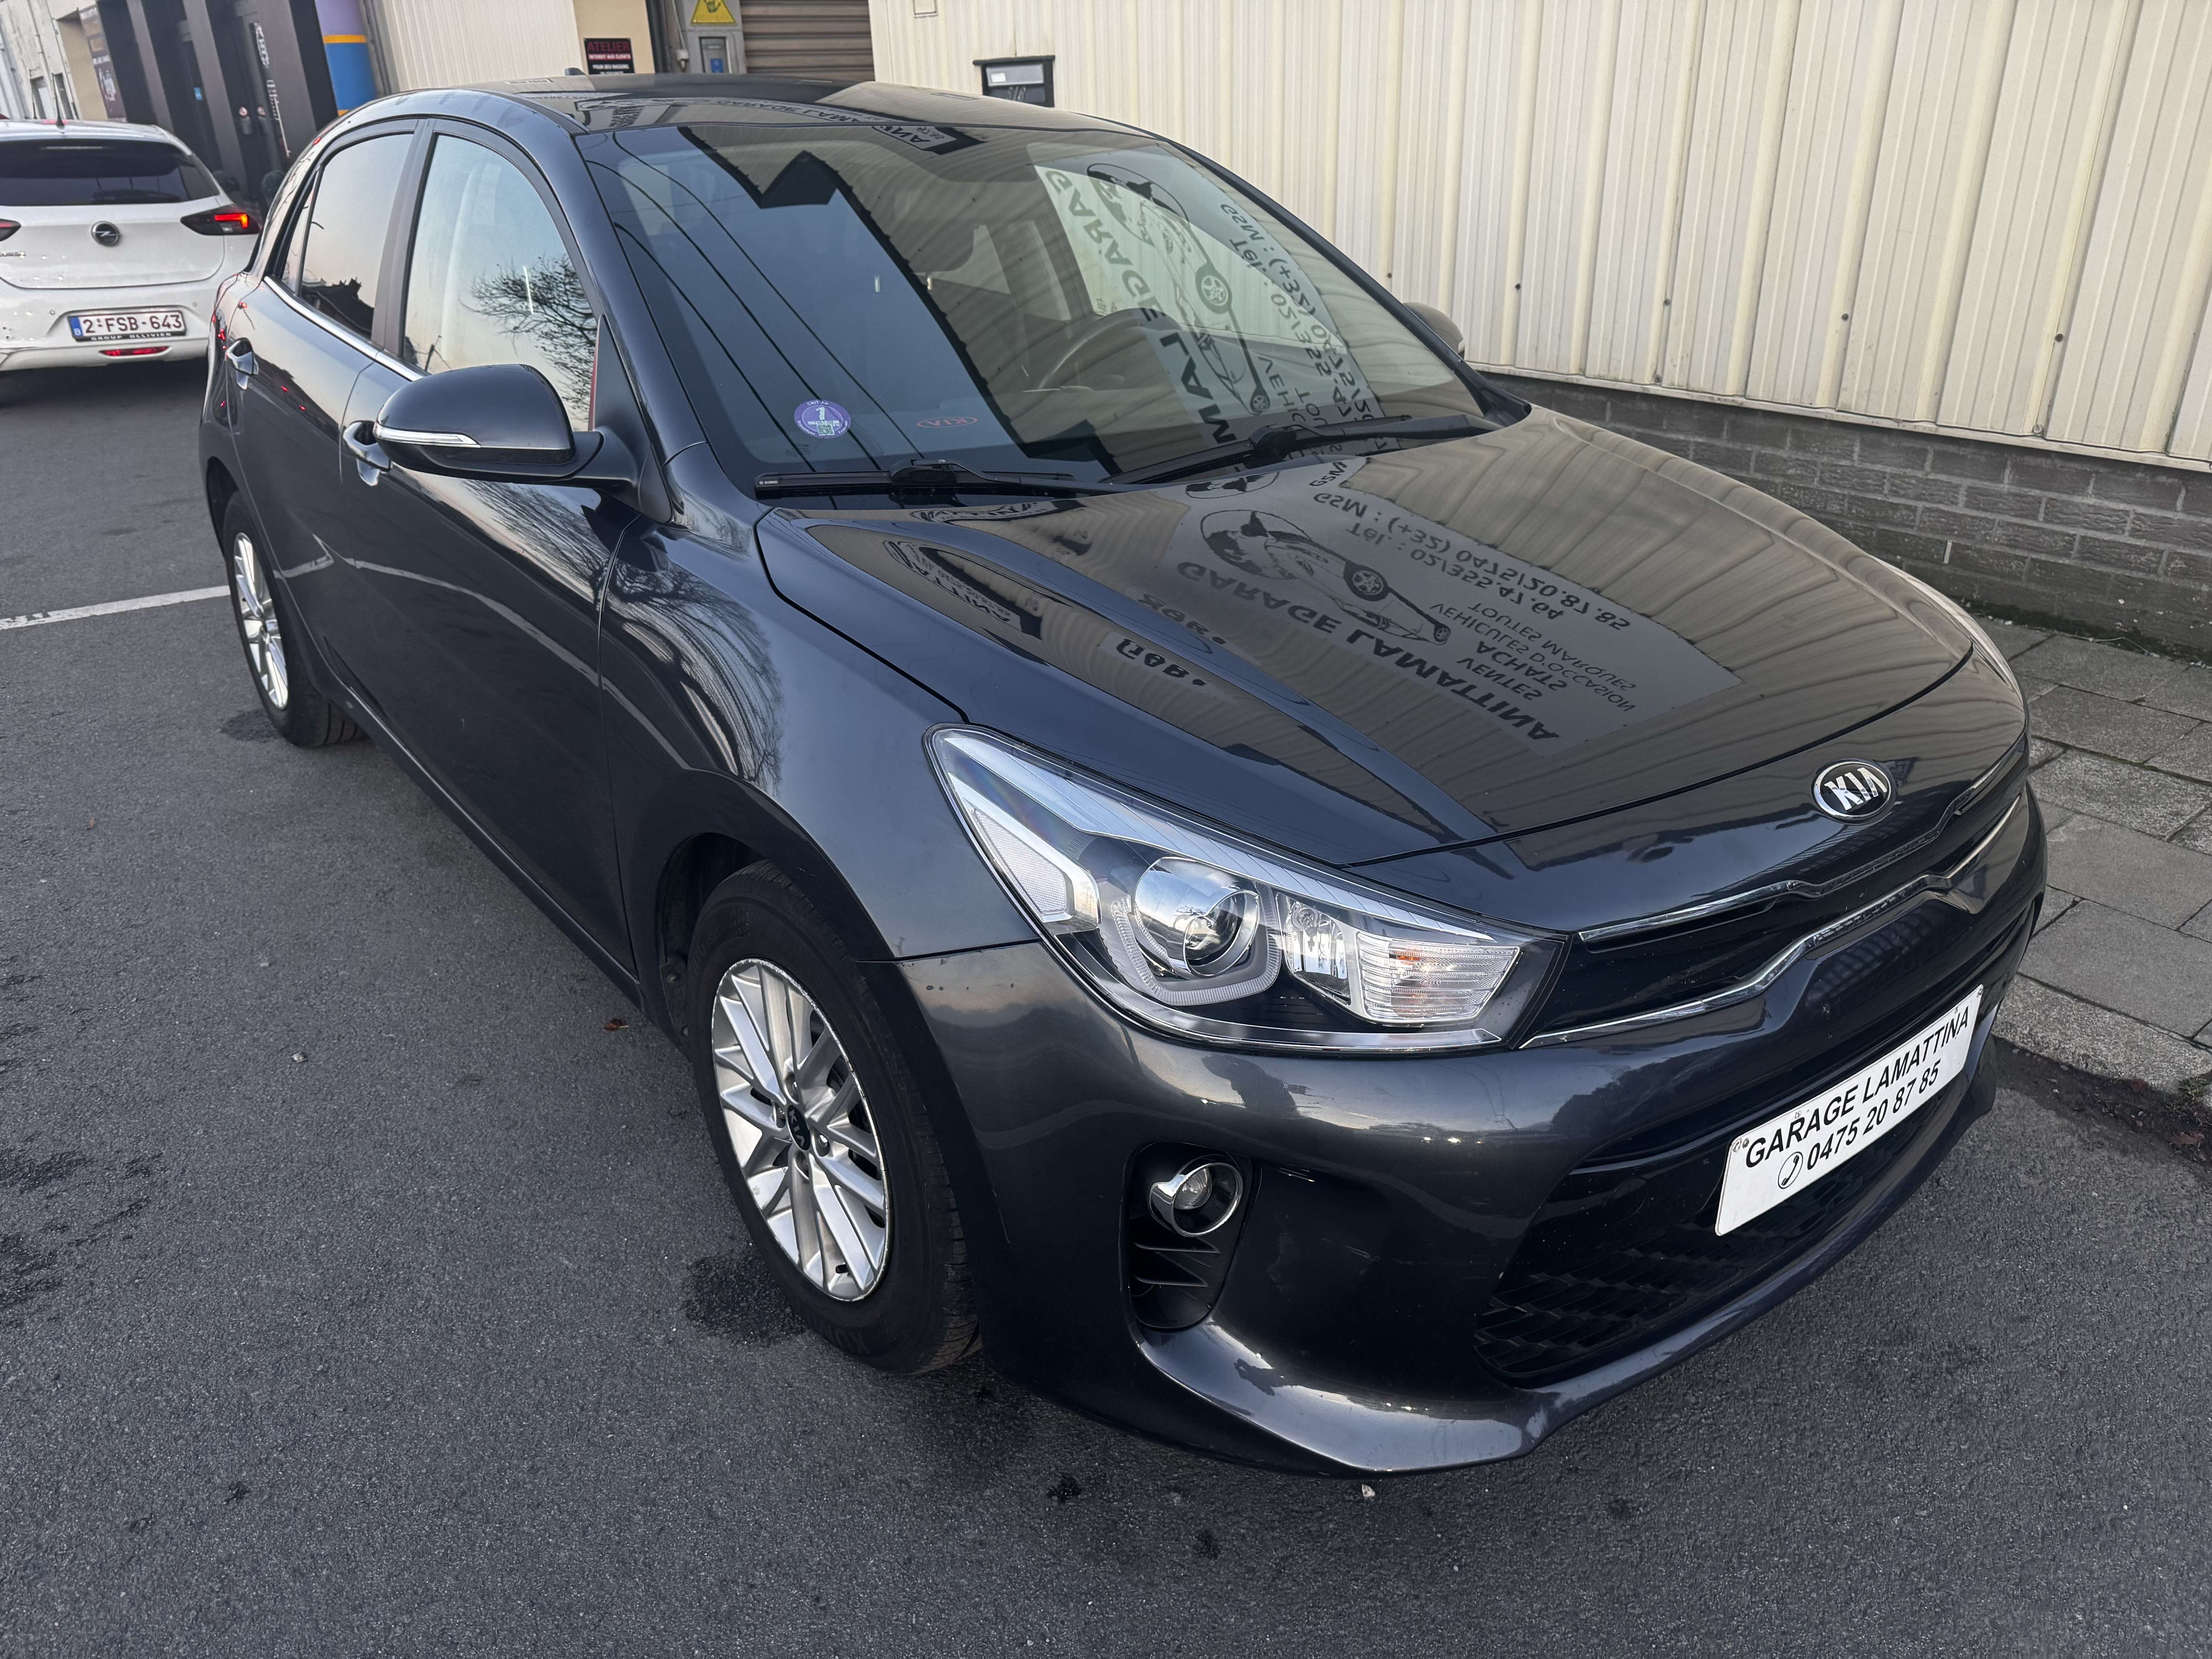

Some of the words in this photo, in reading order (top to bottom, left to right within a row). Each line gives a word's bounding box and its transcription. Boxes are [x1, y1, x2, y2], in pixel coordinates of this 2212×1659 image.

[588, 41, 630, 51] ATELIER
[816, 407, 825, 420] 1
[1824, 767, 1887, 811] KIA
[1746, 1087, 1858, 1168] GARAGE
[1862, 1005, 1969, 1104] LAMATTINA
[789, 1109, 805, 1147] KIA
[1807, 1118, 1859, 1170] 0475
[1863, 1099, 1888, 1135] 20
[1893, 1082, 1916, 1114] 87
[1919, 1060, 1941, 1094] 85
